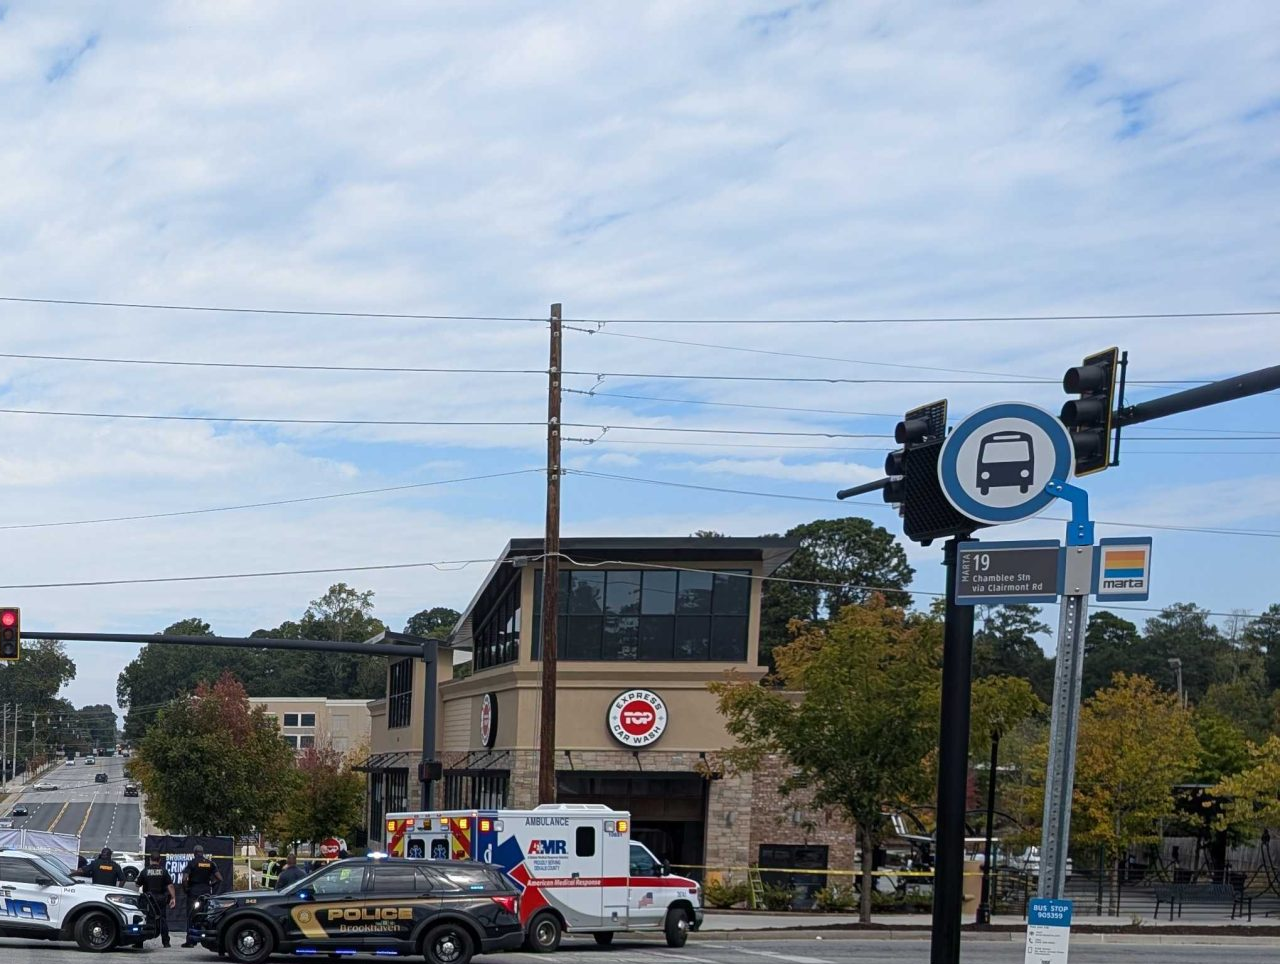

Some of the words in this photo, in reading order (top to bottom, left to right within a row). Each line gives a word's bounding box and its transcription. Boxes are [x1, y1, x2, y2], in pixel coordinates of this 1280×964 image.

[961, 554, 971, 582] MARTA
[973, 554, 990, 571] 19
[973, 574, 1015, 582] Chamblee
[1103, 579, 1144, 589] marta
[988, 583, 1029, 592] Clairmont
[615, 692, 662, 711] EXPRESS
[623, 711, 653, 725] TOP
[614, 725, 630, 741] CAR
[633, 726, 661, 743] WASH
[525, 817, 569, 826] AMBULANCE
[528, 840, 567, 854] AMR
[147, 868, 163, 876] POLICE
[165, 861, 188, 873] CRIM
[327, 908, 413, 920] POLICE
[339, 923, 401, 932] Brookhaven
